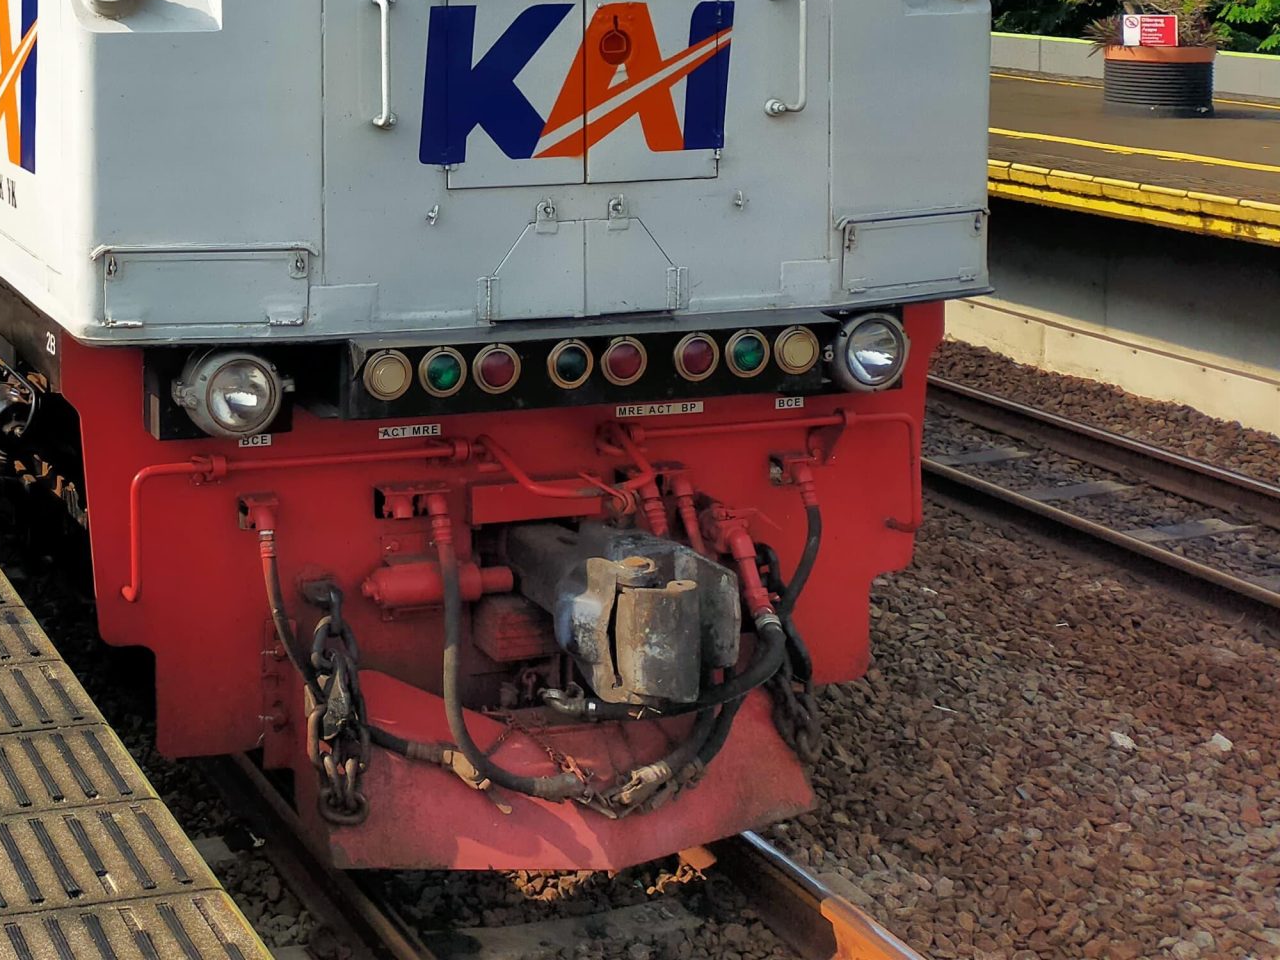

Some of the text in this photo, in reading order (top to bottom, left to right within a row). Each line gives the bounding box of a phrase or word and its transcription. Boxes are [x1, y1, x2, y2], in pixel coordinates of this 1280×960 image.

[419, 1, 735, 165] KAI
[46, 331, 56, 355] 2B
[778, 397, 801, 408] BCE
[618, 403, 697, 416] MRE ACT BP
[382, 425, 438, 438] ACT MRE
[241, 434, 269, 446] BCE
